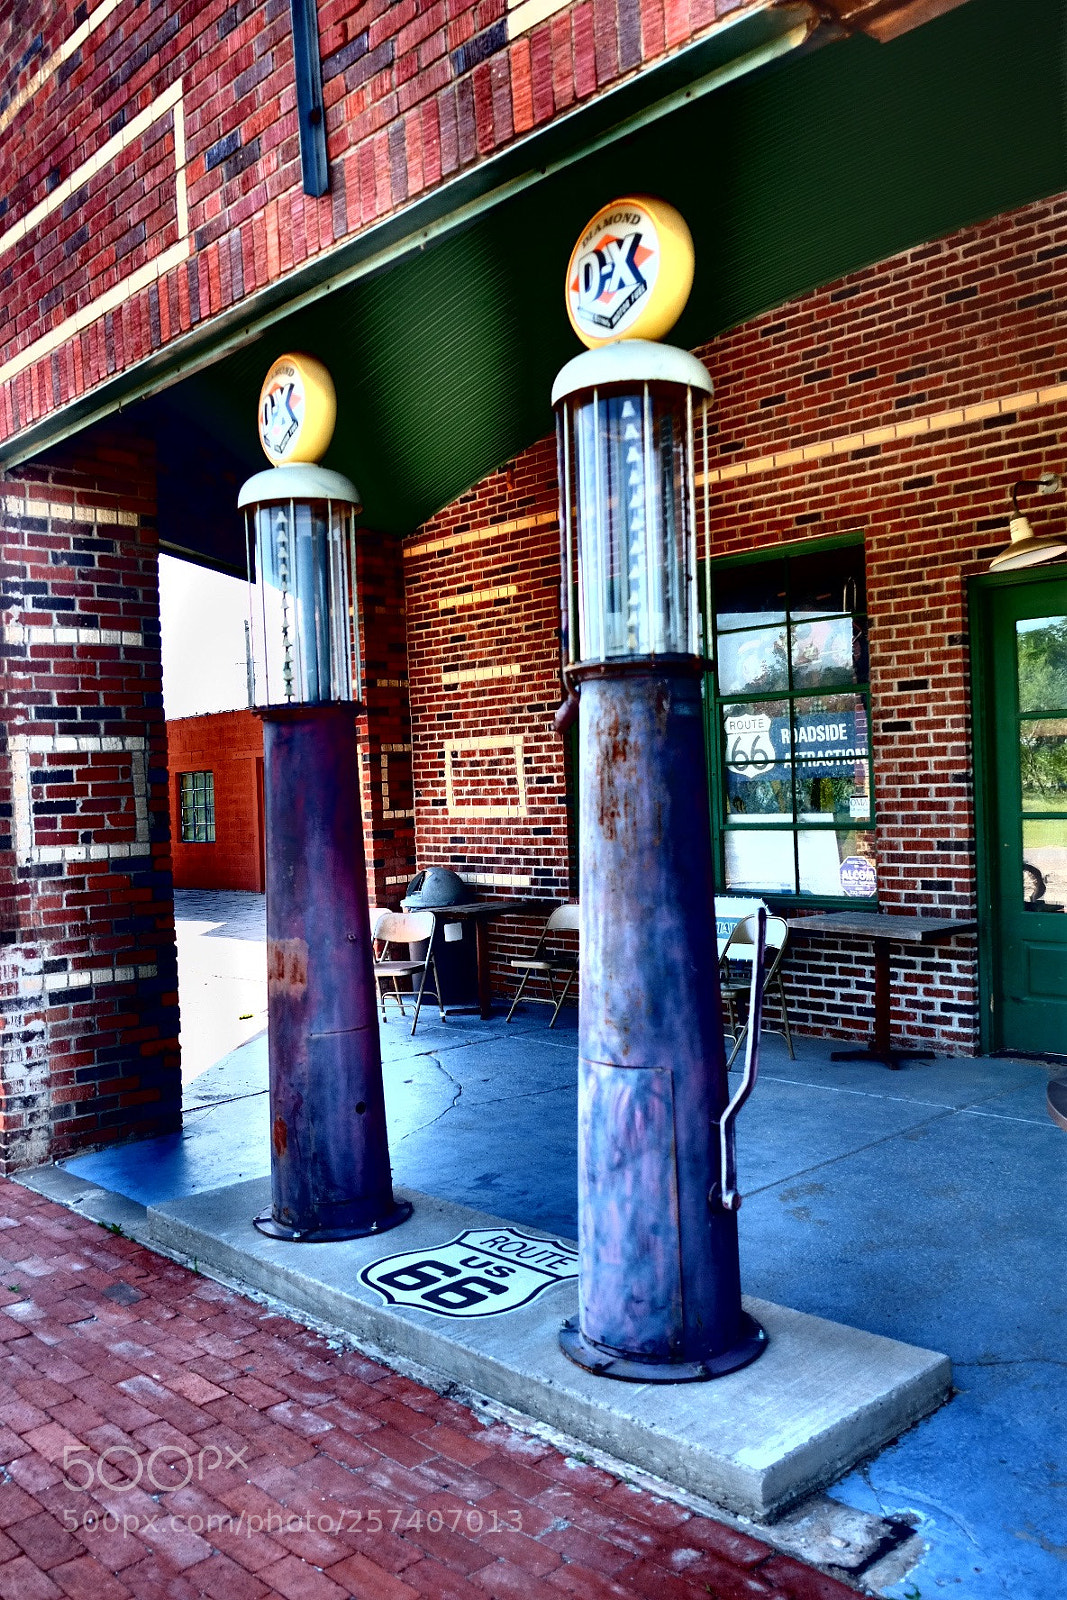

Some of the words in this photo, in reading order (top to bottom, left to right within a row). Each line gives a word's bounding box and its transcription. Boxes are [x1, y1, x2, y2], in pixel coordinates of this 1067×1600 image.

[582, 213, 641, 248] DIAMOND
[578, 232, 642, 307] D-X
[729, 719, 765, 731] ROUTE
[732, 735, 768, 771] 66
[459, 1256, 517, 1278] US
[480, 1235, 578, 1270] ROUTE
[376, 1260, 510, 1309] 66
